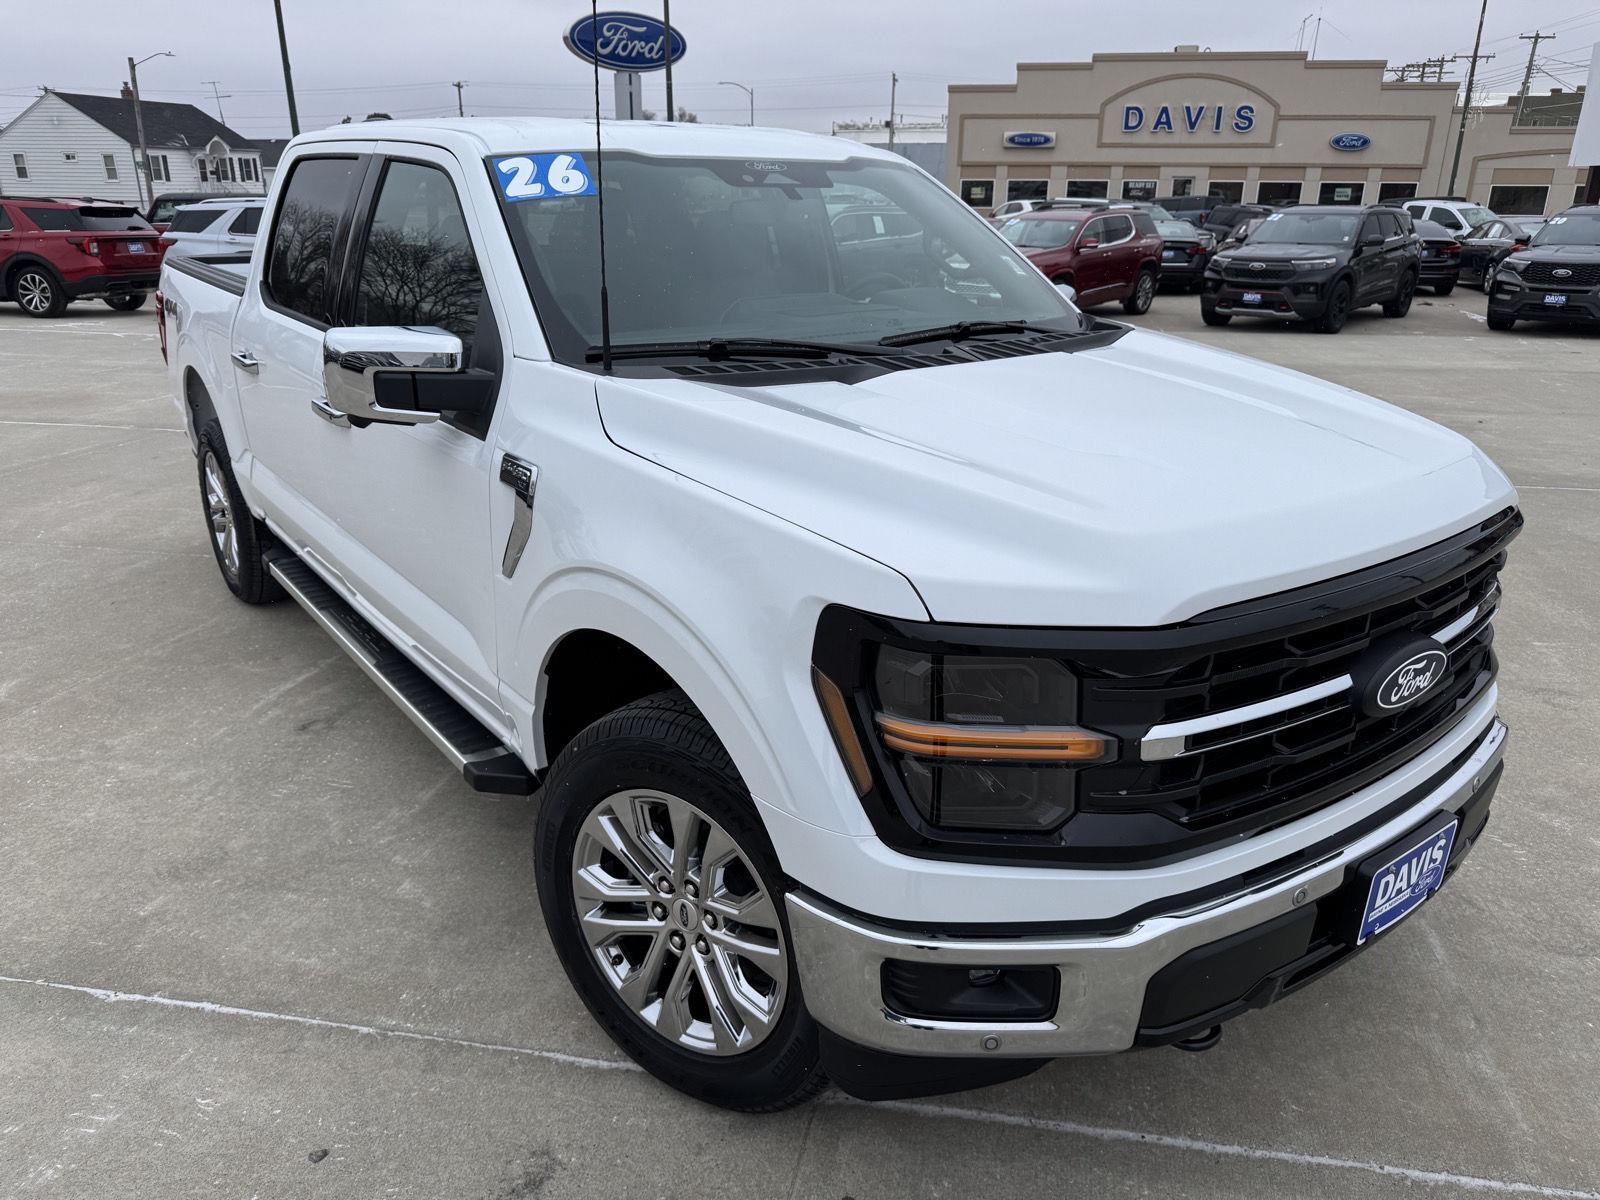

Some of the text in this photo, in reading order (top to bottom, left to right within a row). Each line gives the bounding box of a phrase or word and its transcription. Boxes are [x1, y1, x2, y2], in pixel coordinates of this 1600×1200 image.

[597, 22, 664, 59] Ford
[1122, 104, 1256, 133] DAVIS
[1340, 136, 1364, 147] Ford
[498, 154, 589, 198] 26
[754, 161, 780, 170] Ford
[1545, 294, 1566, 302] DAVIS
[1390, 659, 1437, 703] Ford
[1374, 838, 1447, 909] DAVIS
[1414, 870, 1436, 893] Ford
